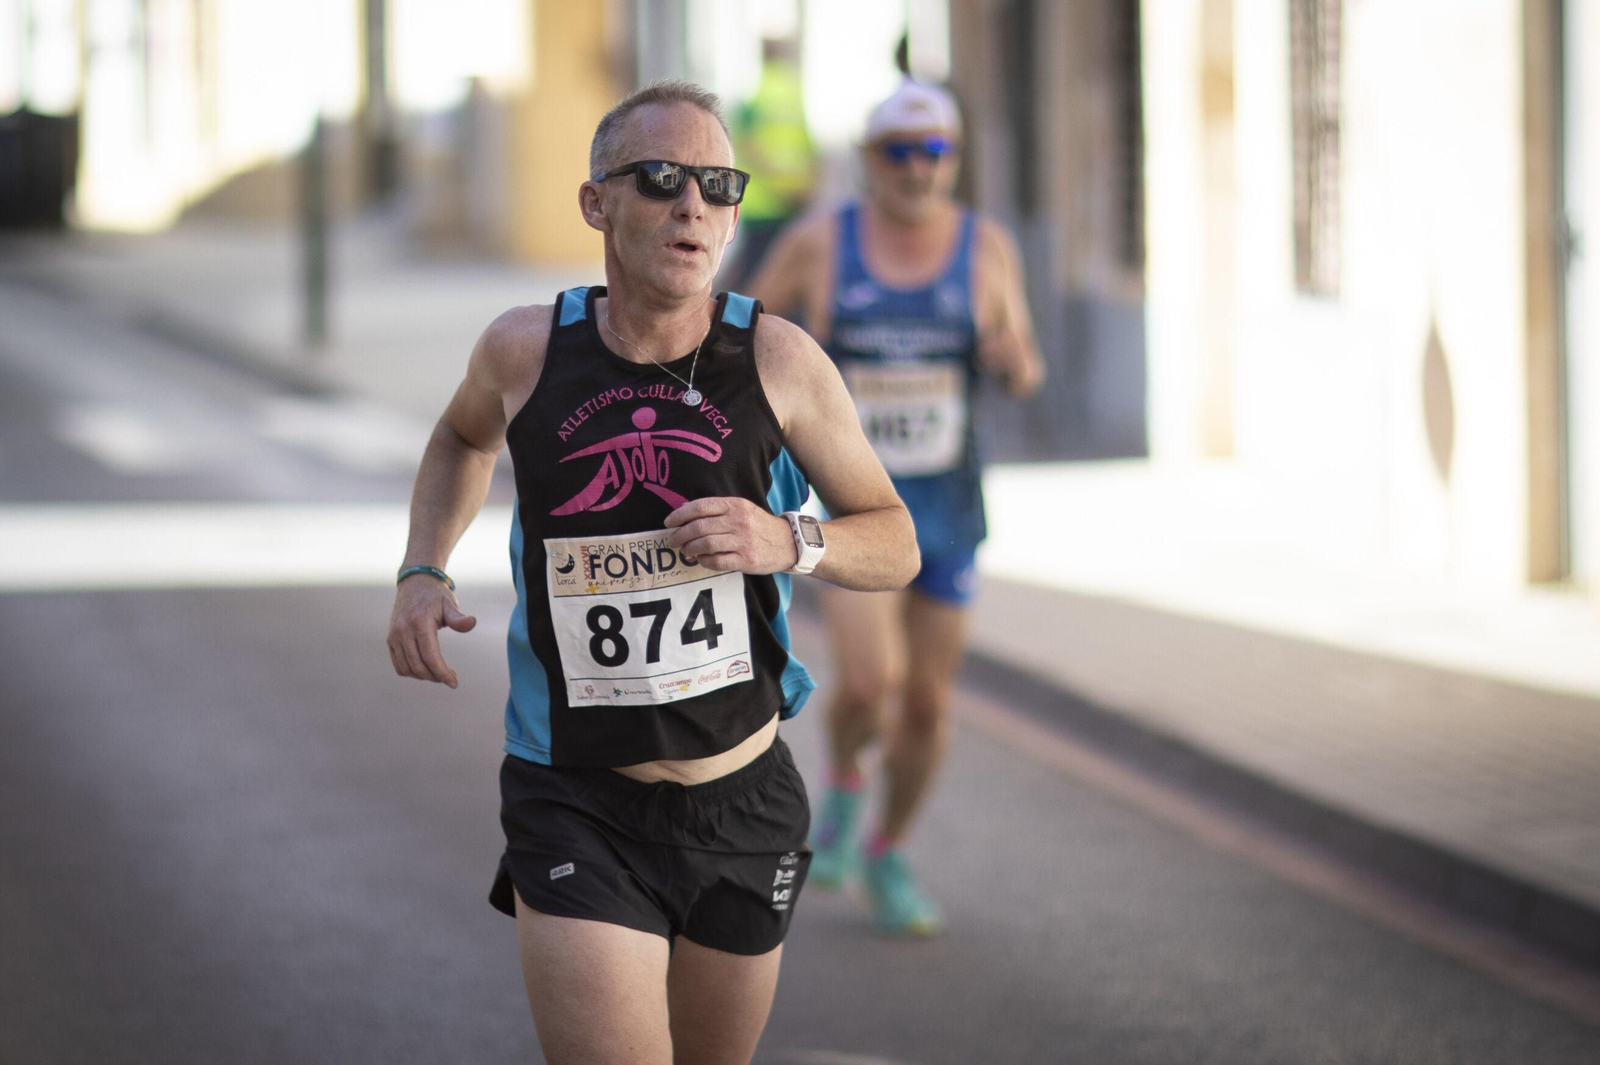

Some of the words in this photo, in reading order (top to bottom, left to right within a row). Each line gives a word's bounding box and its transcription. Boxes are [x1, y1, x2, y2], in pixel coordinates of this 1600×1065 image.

[557, 387, 633, 442] ATLETISMO
[638, 384, 696, 405] CULLA
[699, 398, 733, 440] VEGA
[588, 544, 624, 557] GRAN
[586, 588, 723, 668] 874
